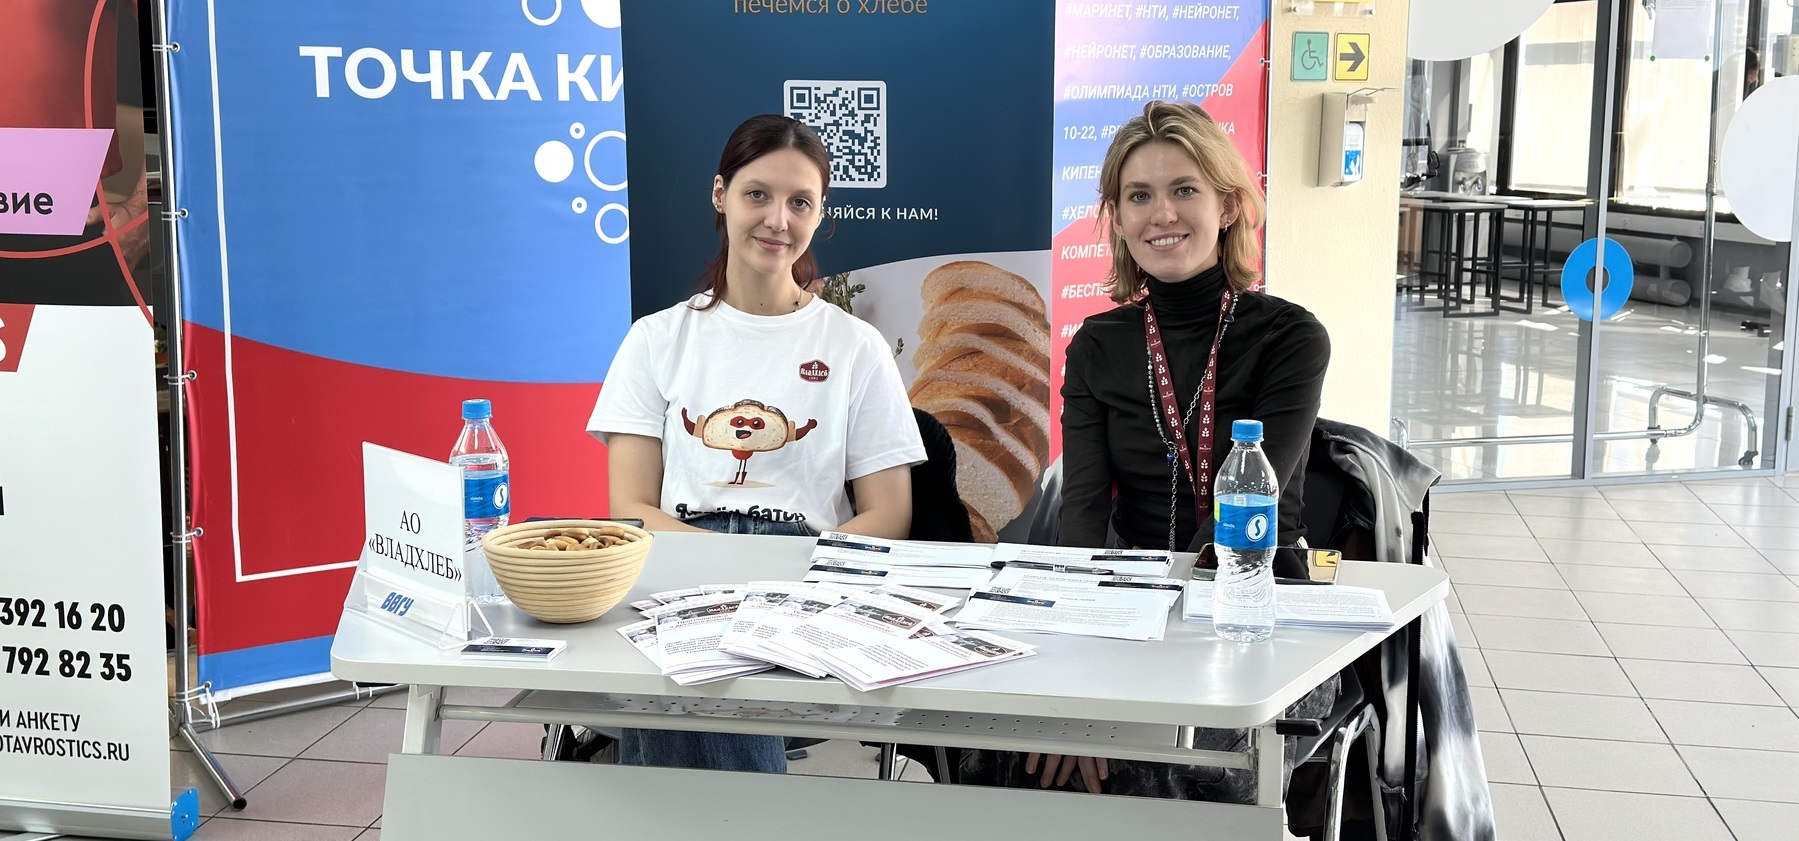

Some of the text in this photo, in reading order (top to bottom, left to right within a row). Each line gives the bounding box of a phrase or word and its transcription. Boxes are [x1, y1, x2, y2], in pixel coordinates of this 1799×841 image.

[836, 0, 850, 14] о
[1063, 3, 1240, 21] #МАРИНЕТ, #НТИ, #НЕЙРОНЕТ,
[1063, 42, 1232, 61] #НЕЙРОНЕТ, #ОБРАЗОВАНИЕ,
[299, 45, 543, 101] ТОЧКА
[1063, 83, 1234, 101] #ОЛИМПИАДА НТИ, #ОСТРОВ
[1063, 125, 1098, 142] 10-22,
[881, 207, 892, 220] К
[896, 207, 939, 221] НАМ!
[399, 510, 421, 535] АО
[368, 533, 462, 582] «ВЛАДХЛЕБ»
[0, 597, 126, 633] 392 16 20
[380, 591, 415, 617] ВВГУ
[2, 645, 132, 682] 792 82 35
[16, 710, 81, 732] АНКЕТУ
